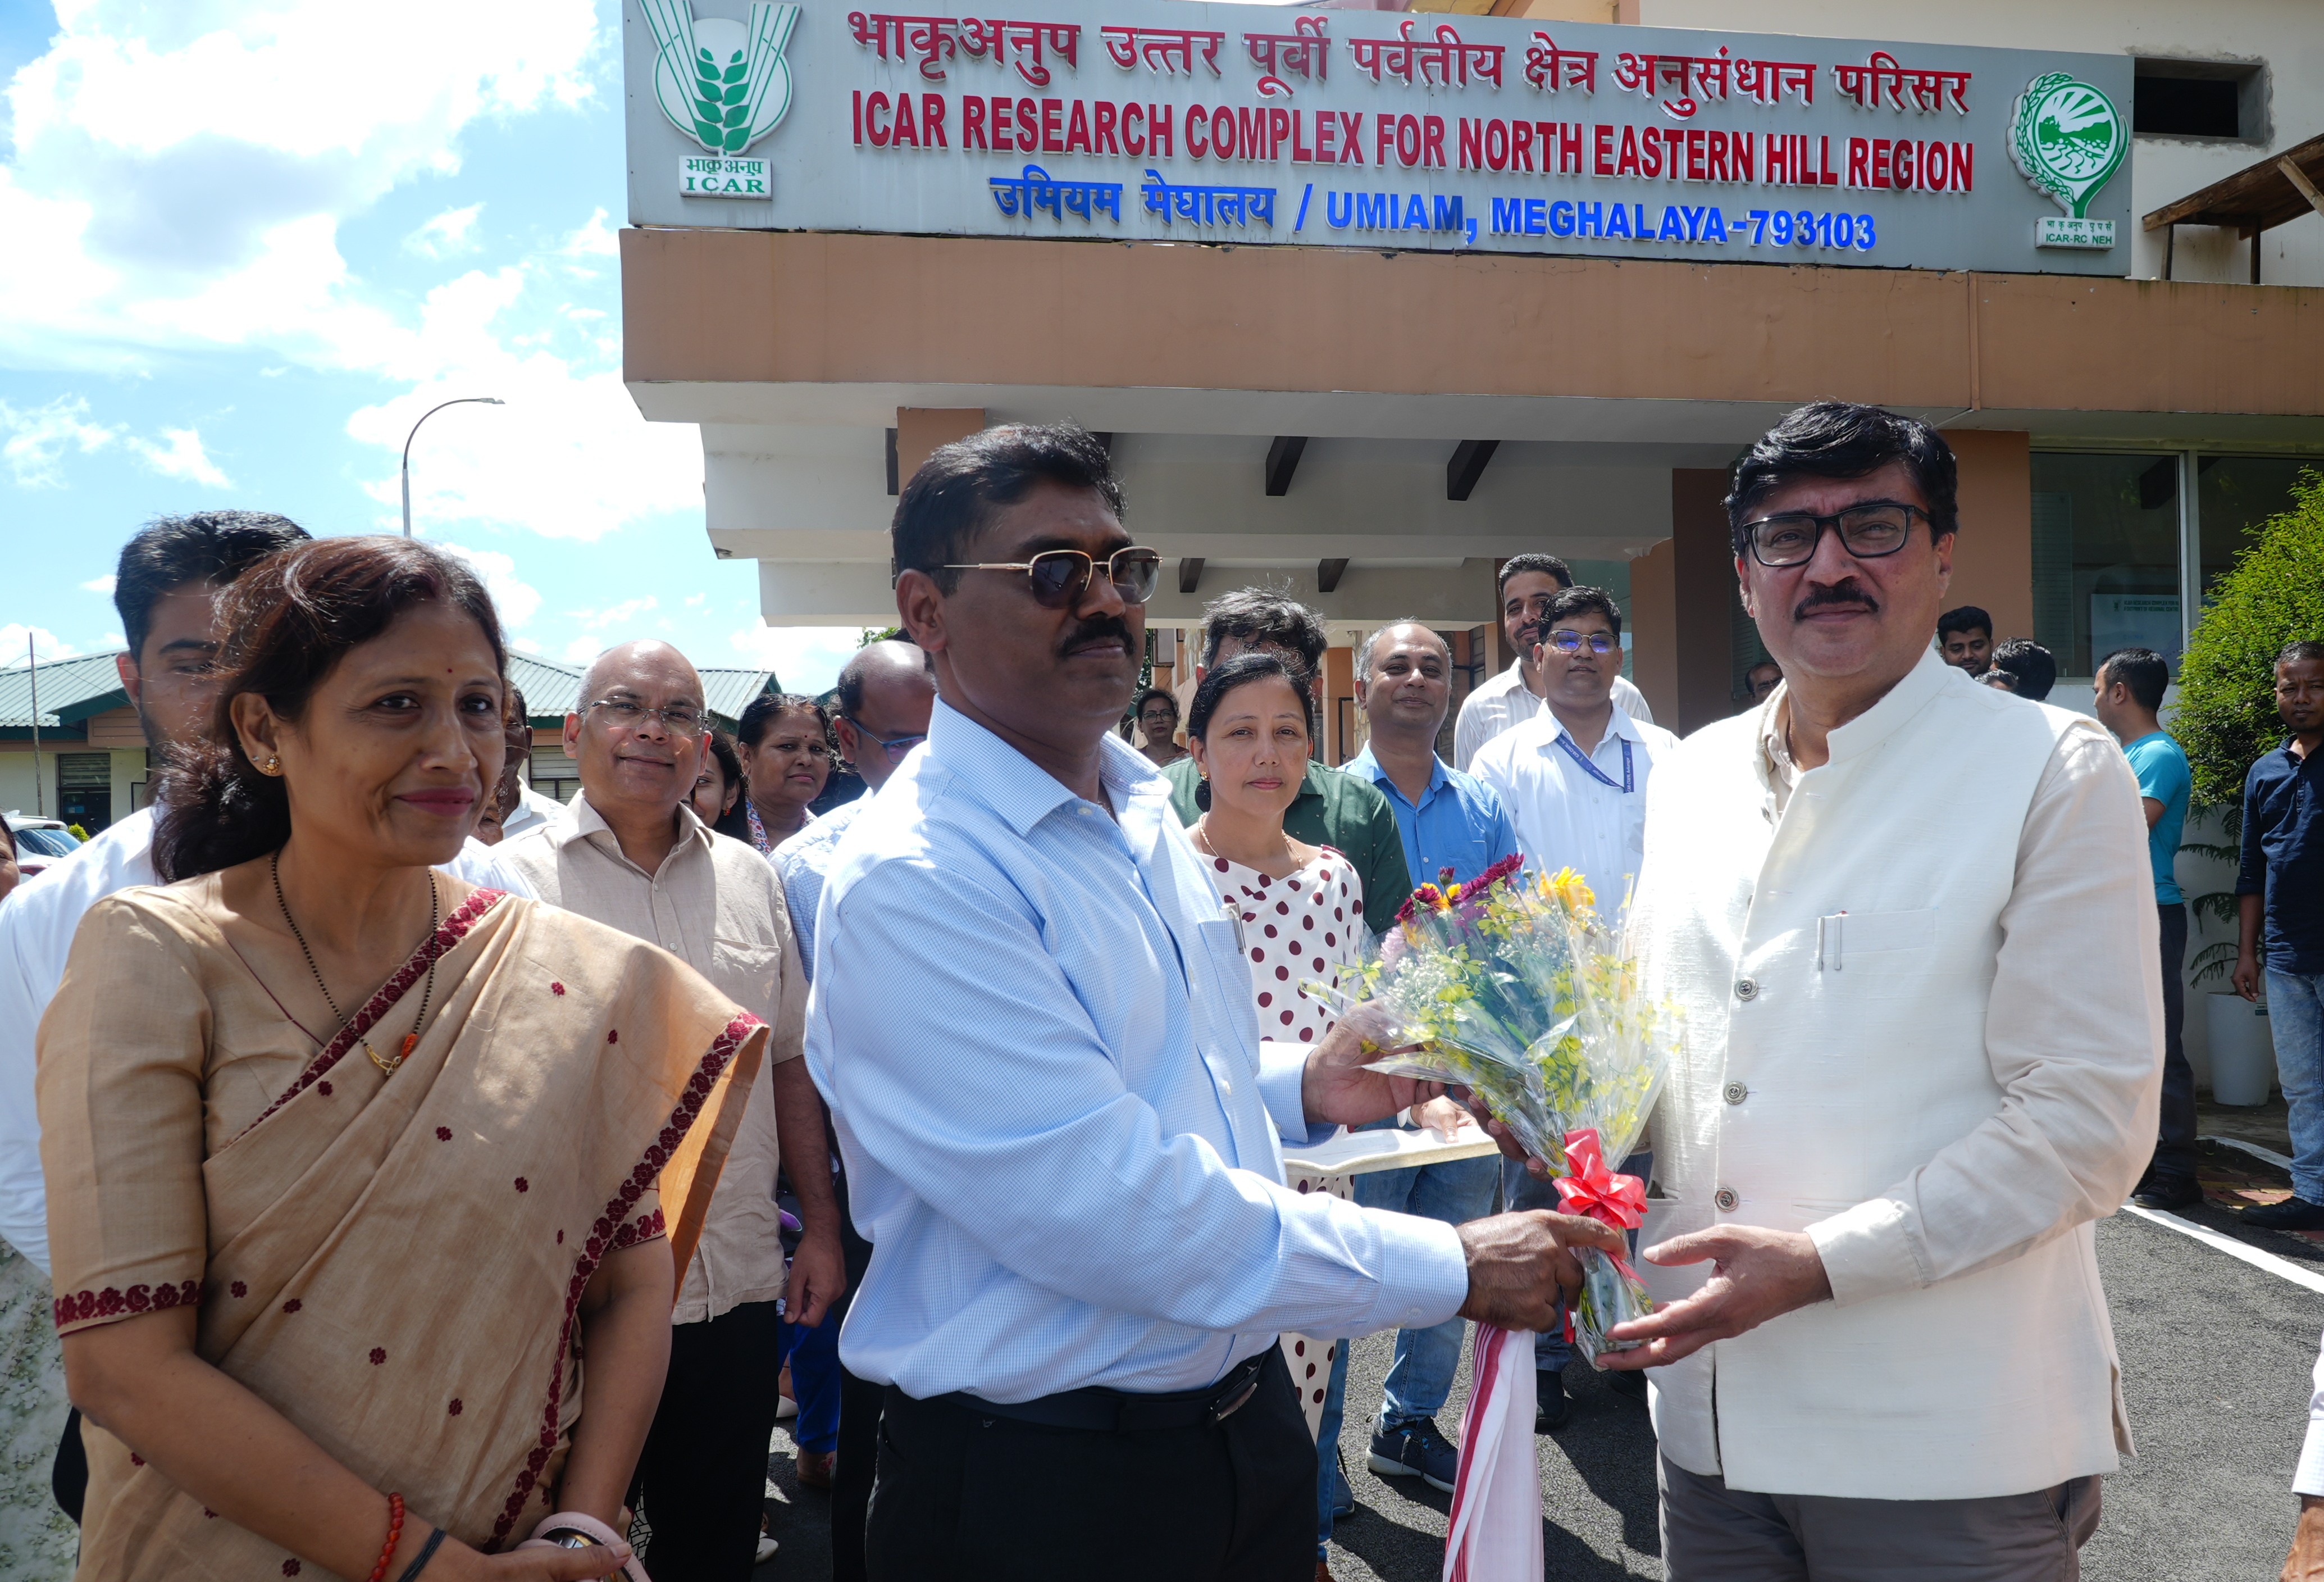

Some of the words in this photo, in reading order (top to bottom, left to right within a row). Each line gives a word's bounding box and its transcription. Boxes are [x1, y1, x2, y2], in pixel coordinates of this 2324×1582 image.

[848, 11, 1081, 87] भाकृअनुप
[1101, 26, 1224, 76] उत्तर
[1243, 16, 1331, 97] पूर्वी
[1348, 21, 1505, 89] पर्वतीय
[1525, 31, 1599, 94] क्षेत्र
[1613, 46, 1817, 119] अनुसंधान
[1832, 51, 1972, 113] परिसर
[686, 177, 765, 193] ICAR
[853, 91, 947, 148] ICAR
[963, 96, 1173, 157] RESEARCH
[1185, 104, 1364, 165] COMPLEX
[1376, 114, 1446, 167] FOR
[1459, 118, 1582, 174] NORTH
[1594, 125, 1753, 181] EASTERN
[1765, 134, 1838, 186] HILL
[1848, 137, 1973, 192] REGION
[989, 164, 1123, 224] उमियम
[1140, 169, 1277, 228] मेघालय
[1294, 183, 1314, 232] /
[1327, 191, 1478, 245] UMIAM,
[1491, 197, 1877, 251] MEGHALAYA-793103
[2046, 234, 2087, 243] ICAR-RC
[2092, 235, 2112, 244] NEH
